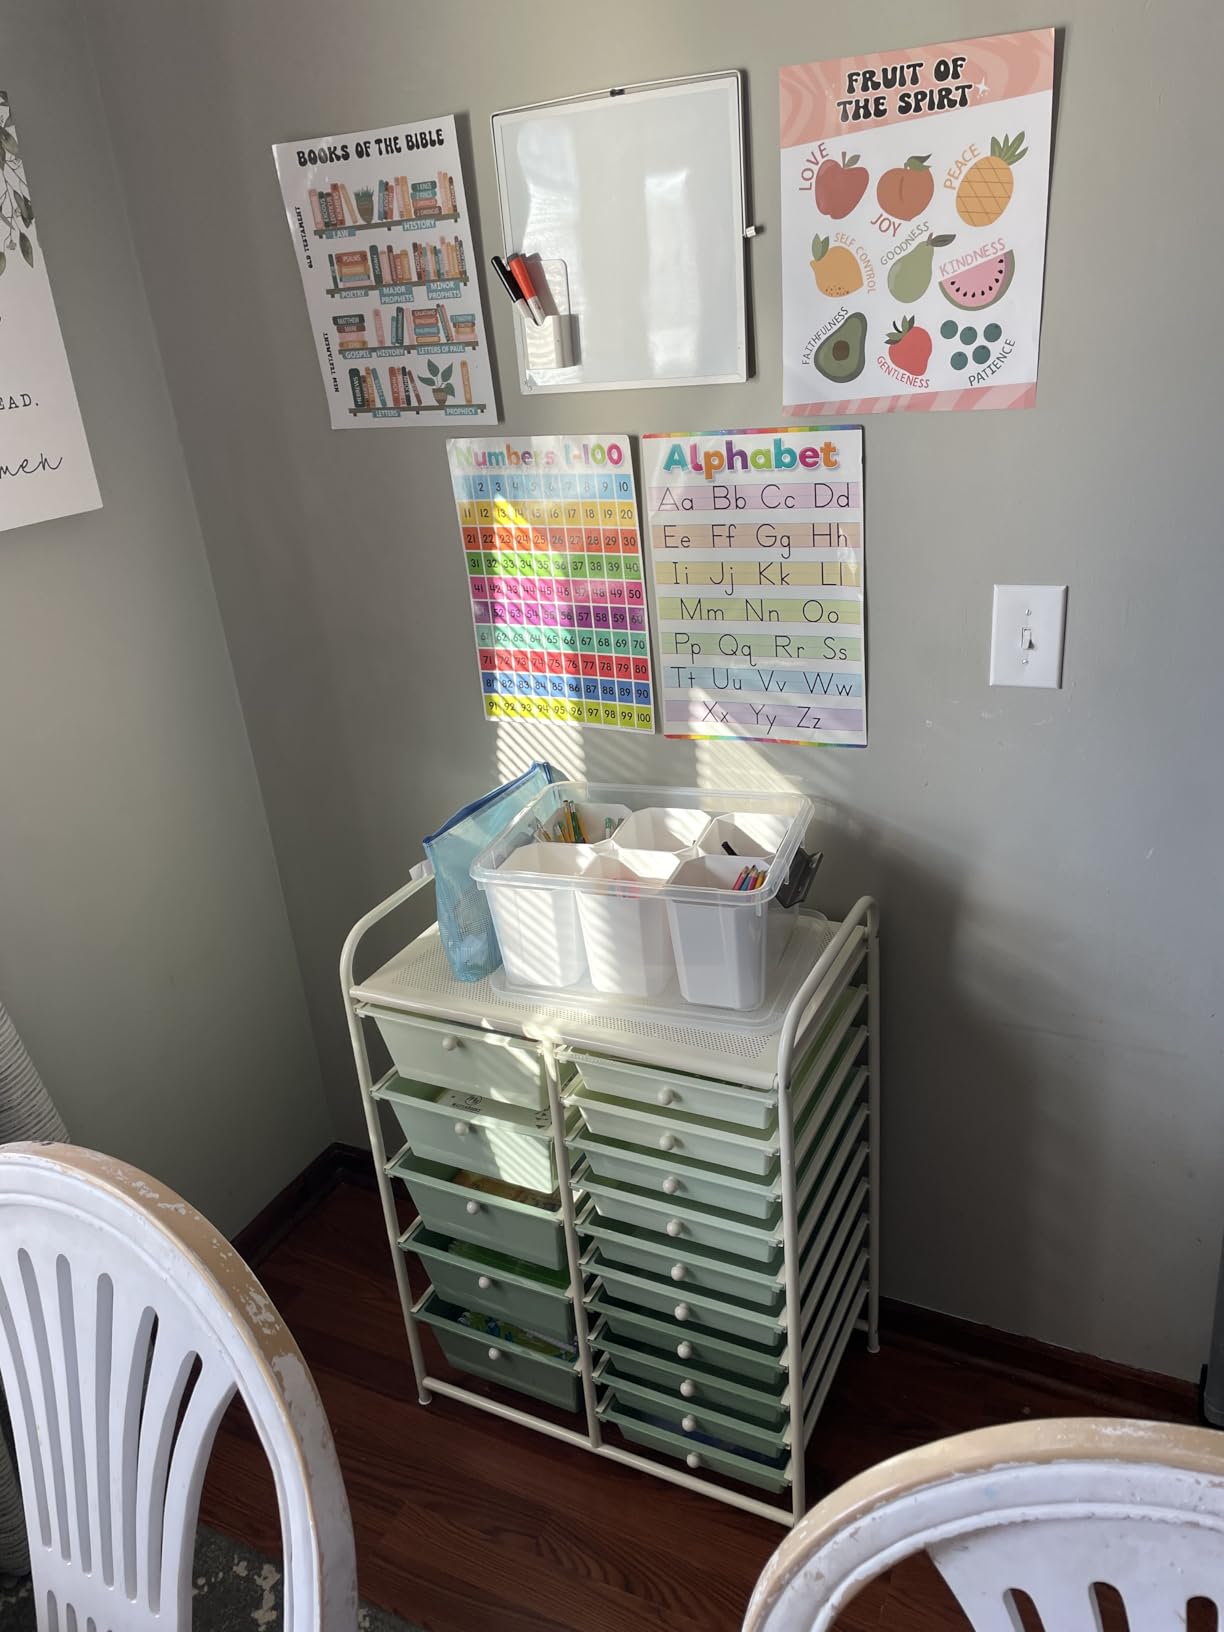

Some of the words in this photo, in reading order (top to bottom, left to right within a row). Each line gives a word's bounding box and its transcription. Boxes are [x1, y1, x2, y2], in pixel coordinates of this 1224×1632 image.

[847, 62, 924, 94] FRUIT
[934, 57, 966, 82] OF
[837, 96, 887, 122] THE
[898, 84, 973, 115] SPIRT
[296, 144, 350, 167] BOOKS
[355, 141, 371, 158] OF
[374, 136, 402, 156] THE
[405, 129, 444, 151] BIBLE
[799, 142, 829, 191] LOVE
[943, 143, 981, 191] PEACE
[294, 206, 310, 252] TESTAMENT
[332, 230, 349, 238] LAW
[403, 219, 435, 231] HISTORY
[870, 213, 901, 237] JOY
[880, 221, 930, 266] GOODNESS
[833, 232, 856, 247] SELF
[855, 246, 877, 294] CONTROL
[939, 237, 1006, 277] KINDNESS
[341, 290, 365, 298] POETRY
[428, 290, 461, 300] PROPHETS
[430, 282, 455, 290] MINOR
[381, 294, 414, 304] PROPHETS
[802, 306, 849, 365] FAITHFULNESS
[323, 332, 336, 375] TESTAMENT
[376, 348, 404, 357] HISTORY
[450, 345, 465, 353] PAUL
[877, 355, 930, 389] GENTLENESS
[968, 338, 1015, 387] PATIENCE
[332, 377, 340, 393] NEW
[375, 409, 398, 417] LETTERS
[446, 408, 475, 416] PROPHECY
[454, 442, 555, 467] Numbers
[564, 443, 624, 466] 1-100
[663, 438, 837, 480] Alphabet
[478, 482, 484, 491] 2
[496, 482, 501, 491] 3
[603, 482, 609, 492] 9
[619, 482, 628, 492] 10
[658, 487, 693, 510] Aa
[712, 485, 747, 510] Bb
[761, 484, 795, 509] Cc
[814, 482, 850, 508] Dd
[464, 509, 471, 518] 11
[480, 509, 488, 518] 12
[497, 509, 506, 518] 13
[550, 510, 558, 518] 16
[568, 509, 576, 519] 17
[586, 509, 595, 519] 18
[604, 509, 613, 519] 19
[621, 510, 632, 519] 20
[467, 534, 475, 543] 21
[482, 534, 494, 543] 22
[534, 535, 545, 544] 25
[587, 535, 599, 544] 28
[606, 536, 617, 546] 29
[624, 536, 636, 546] 30
[664, 525, 691, 548] Ee
[712, 524, 737, 548] Ff
[756, 523, 791, 559] Gg
[813, 522, 848, 547] Hh
[471, 560, 479, 568] 31
[486, 559, 497, 568] 32
[503, 560, 514, 569] 33
[520, 560, 531, 569] 34
[538, 560, 548, 569] 35
[573, 561, 583, 570] 37
[590, 562, 601, 571] 38
[608, 562, 619, 572] 39
[626, 563, 638, 573] 40
[672, 561, 689, 584] Ii
[710, 561, 734, 596] Jj
[759, 562, 790, 585] Kk
[821, 562, 842, 586] Ll
[474, 584, 483, 592] 41
[489, 584, 500, 593] 42
[540, 586, 551, 595] 45
[558, 587, 570, 596] 46
[610, 588, 622, 598] 49
[629, 590, 640, 599] 50
[492, 609, 503, 618] 52
[561, 611, 572, 621] 56
[577, 612, 588, 622] 57
[595, 613, 606, 622] 58
[613, 614, 624, 623] 59
[680, 598, 724, 621] Mm
[745, 598, 780, 622] Nn
[802, 600, 839, 623] Oo
[495, 633, 507, 642] 62
[545, 635, 557, 644] 65
[563, 636, 574, 645] 66
[581, 637, 592, 646] 67
[597, 638, 608, 647] 68
[615, 639, 626, 648] 69
[633, 640, 644, 650] 70
[675, 632, 701, 664] Pp
[719, 634, 757, 667] Qq
[775, 635, 805, 658] Rr
[823, 636, 847, 660] Ss
[483, 656, 491, 664] 71
[549, 659, 560, 668] 75
[566, 660, 577, 670] 76
[583, 661, 594, 671] 77
[600, 662, 611, 672] 78
[617, 663, 628, 673] 79
[635, 664, 646, 674] 80
[487, 679, 494, 688] 81
[502, 680, 513, 689] 82
[518, 681, 529, 690] 83
[534, 682, 545, 691] 84
[552, 683, 563, 692] 85
[569, 684, 580, 693] 86
[586, 685, 597, 695] 87
[602, 686, 613, 696] 88
[619, 688, 631, 697] 89
[637, 689, 648, 699] 90
[670, 666, 696, 688] Tt
[713, 668, 742, 690] Uu
[758, 669, 786, 692] Vv
[803, 671, 852, 696] Ww
[489, 701, 498, 710] 91
[505, 702, 516, 712] 92
[521, 704, 532, 713] 93
[538, 704, 548, 713] 94
[554, 706, 565, 715] 95
[571, 707, 583, 716] 96
[587, 709, 598, 718] 97
[604, 710, 616, 719] 98
[622, 711, 633, 721] 99
[637, 714, 650, 722] 100
[702, 701, 729, 722] Xx
[750, 704, 777, 735] Yy
[796, 706, 822, 729] Zz
